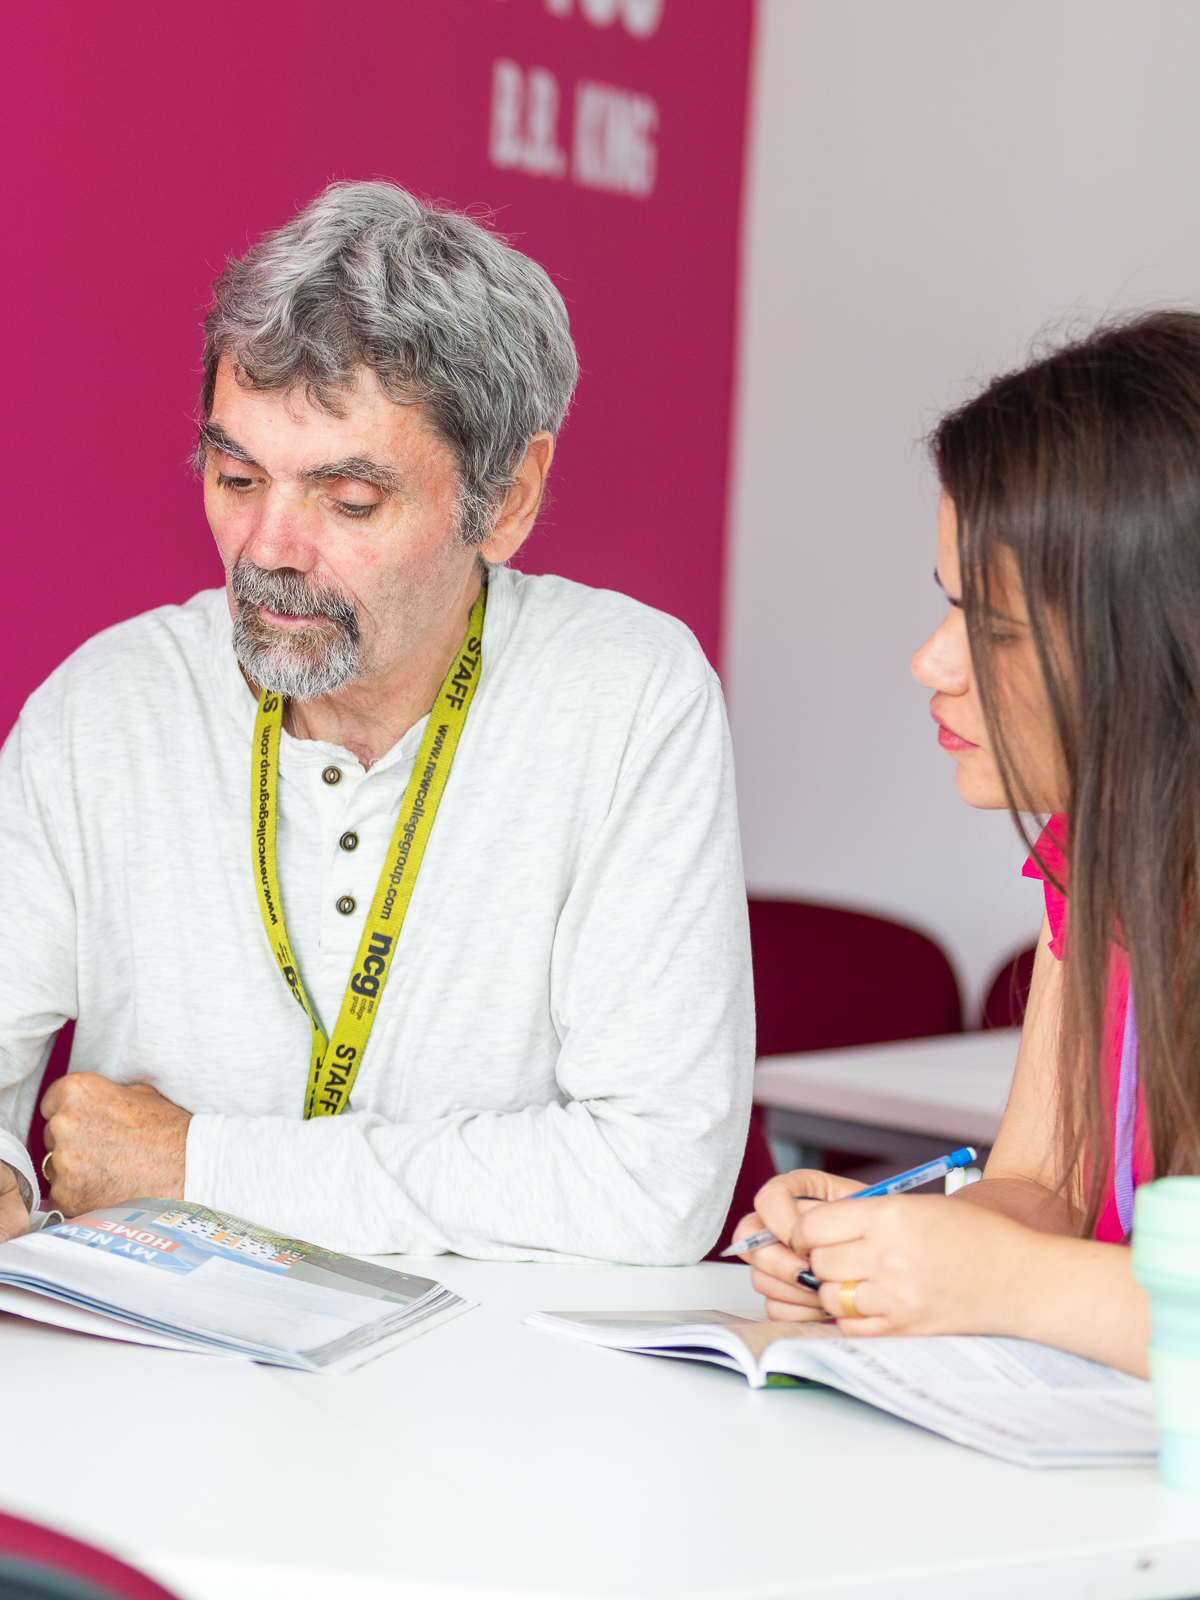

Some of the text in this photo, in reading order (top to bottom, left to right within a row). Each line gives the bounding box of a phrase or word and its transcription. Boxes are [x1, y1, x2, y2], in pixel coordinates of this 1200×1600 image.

[445, 635, 482, 711] STAFF
[256, 725, 278, 925] www.newcollegegroup.com
[380, 724, 449, 920] www.newcollegegroup.com
[351, 931, 393, 999] ncg
[349, 996, 360, 1015] group
[356, 998, 367, 1021] college
[319, 1043, 357, 1115] STAFF
[52, 1225, 159, 1261] MY NEW
[96, 1220, 174, 1250] HOME
